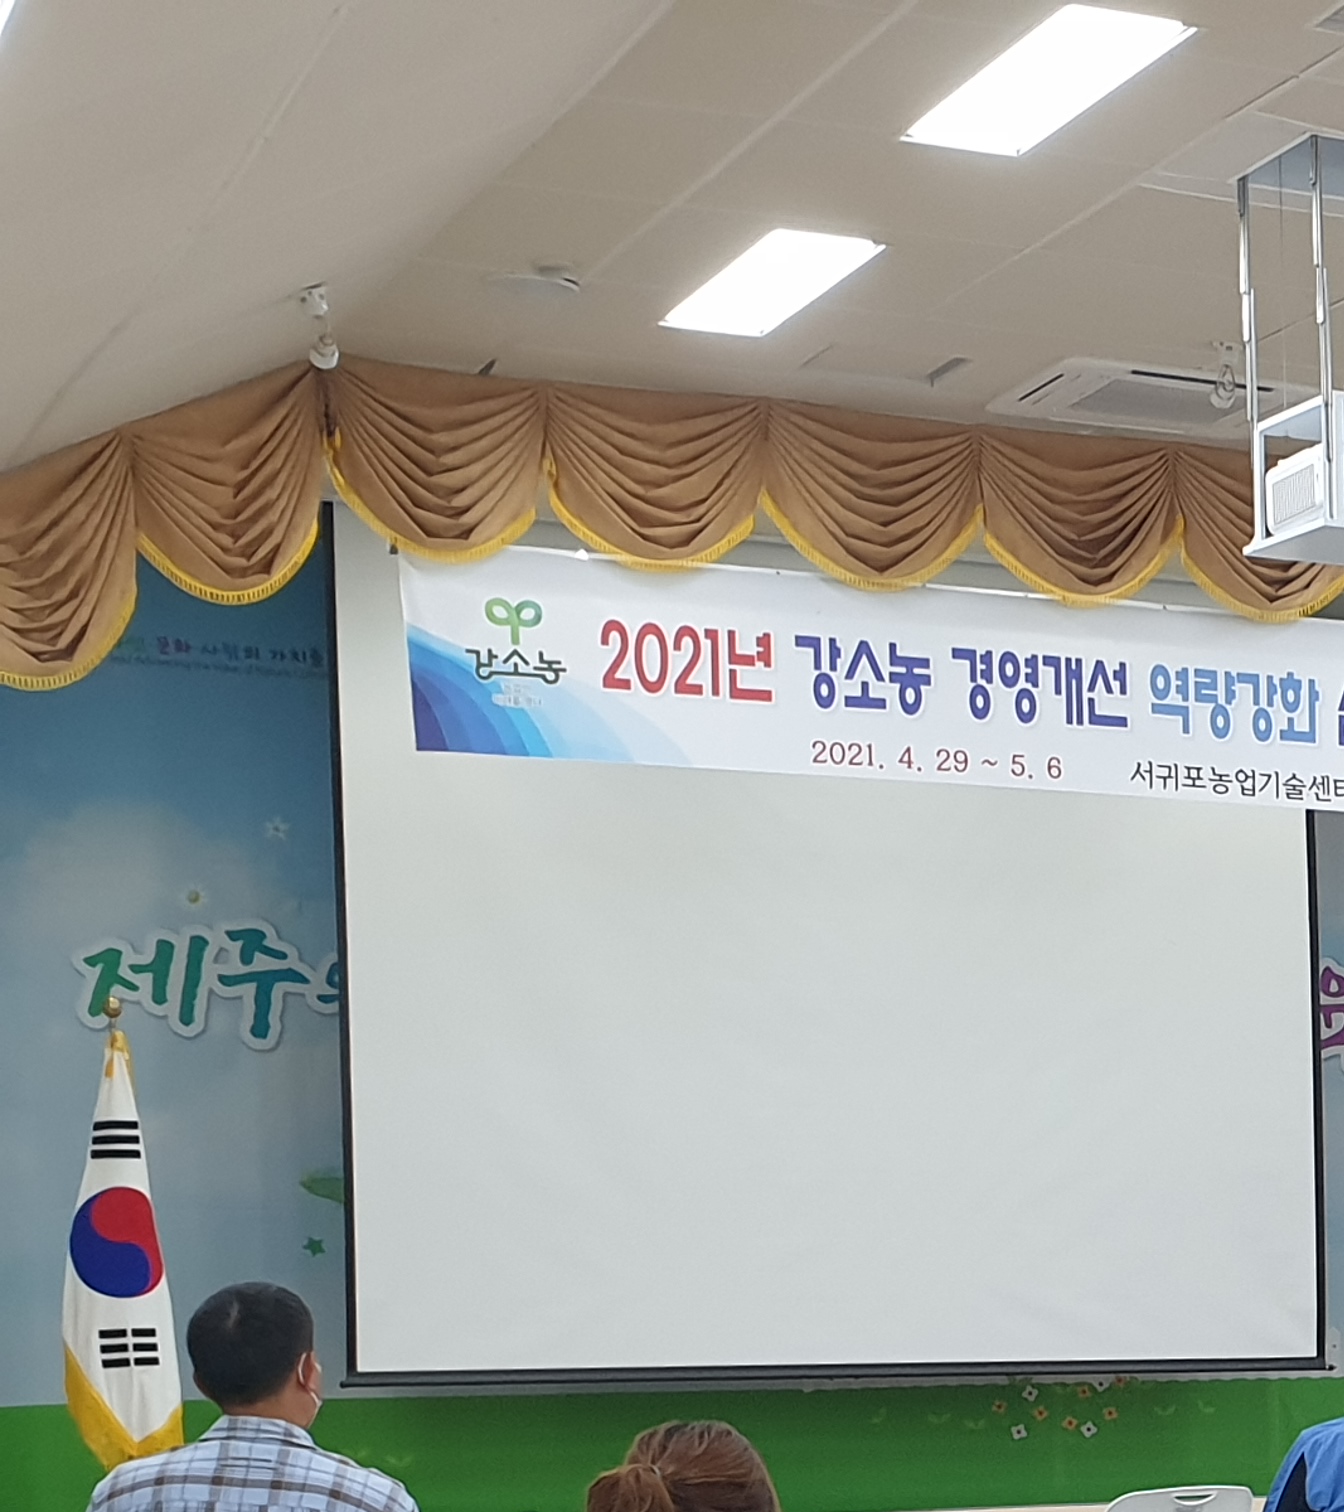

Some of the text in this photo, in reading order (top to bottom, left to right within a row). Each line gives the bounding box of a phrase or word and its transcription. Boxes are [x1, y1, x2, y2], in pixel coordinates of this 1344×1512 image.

[466, 647, 567, 685] 강소농
[600, 618, 774, 703] 2021년
[795, 635, 932, 717] 강소농
[951, 647, 1128, 730] 경영개선
[1149, 663, 1319, 745] 역량강화
[811, 740, 885, 771] 2021.
[897, 746, 923, 773] 4.
[935, 749, 969, 774] 29
[1010, 753, 1035, 780] 5.
[1046, 756, 1063, 779] 6
